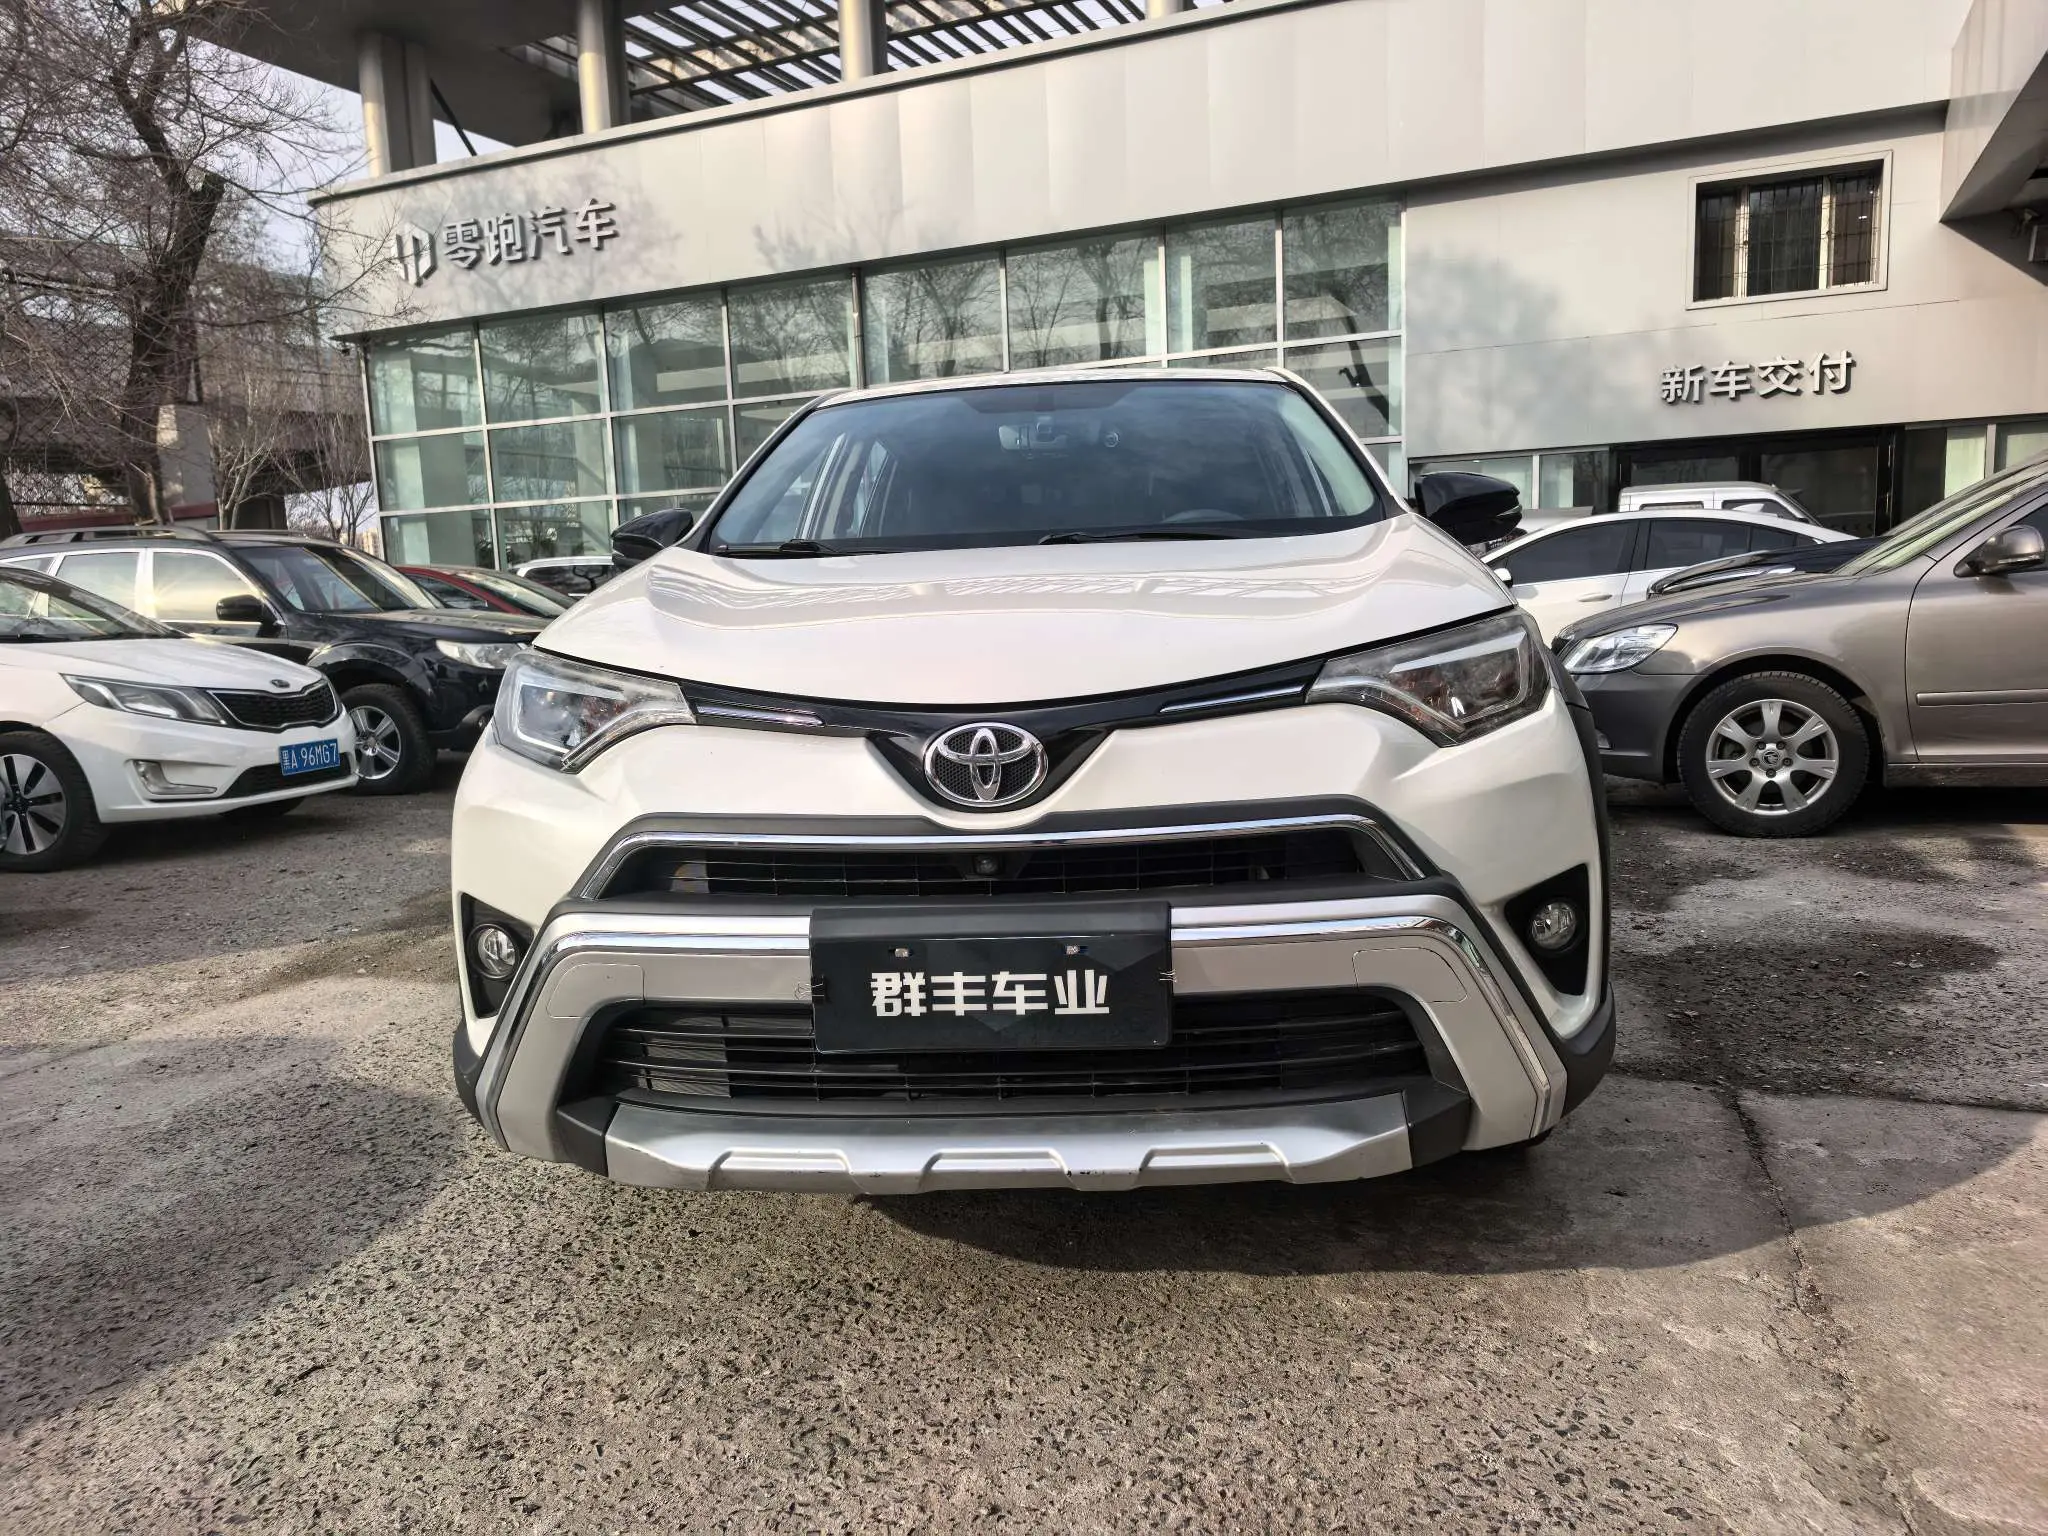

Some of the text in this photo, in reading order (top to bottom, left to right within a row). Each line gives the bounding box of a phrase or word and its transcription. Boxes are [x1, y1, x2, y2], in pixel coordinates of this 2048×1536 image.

[444, 198, 617, 268] 零跑汽车
[1661, 350, 1855, 404] 新车交付
[870, 969, 1110, 1017] 群丰车业
